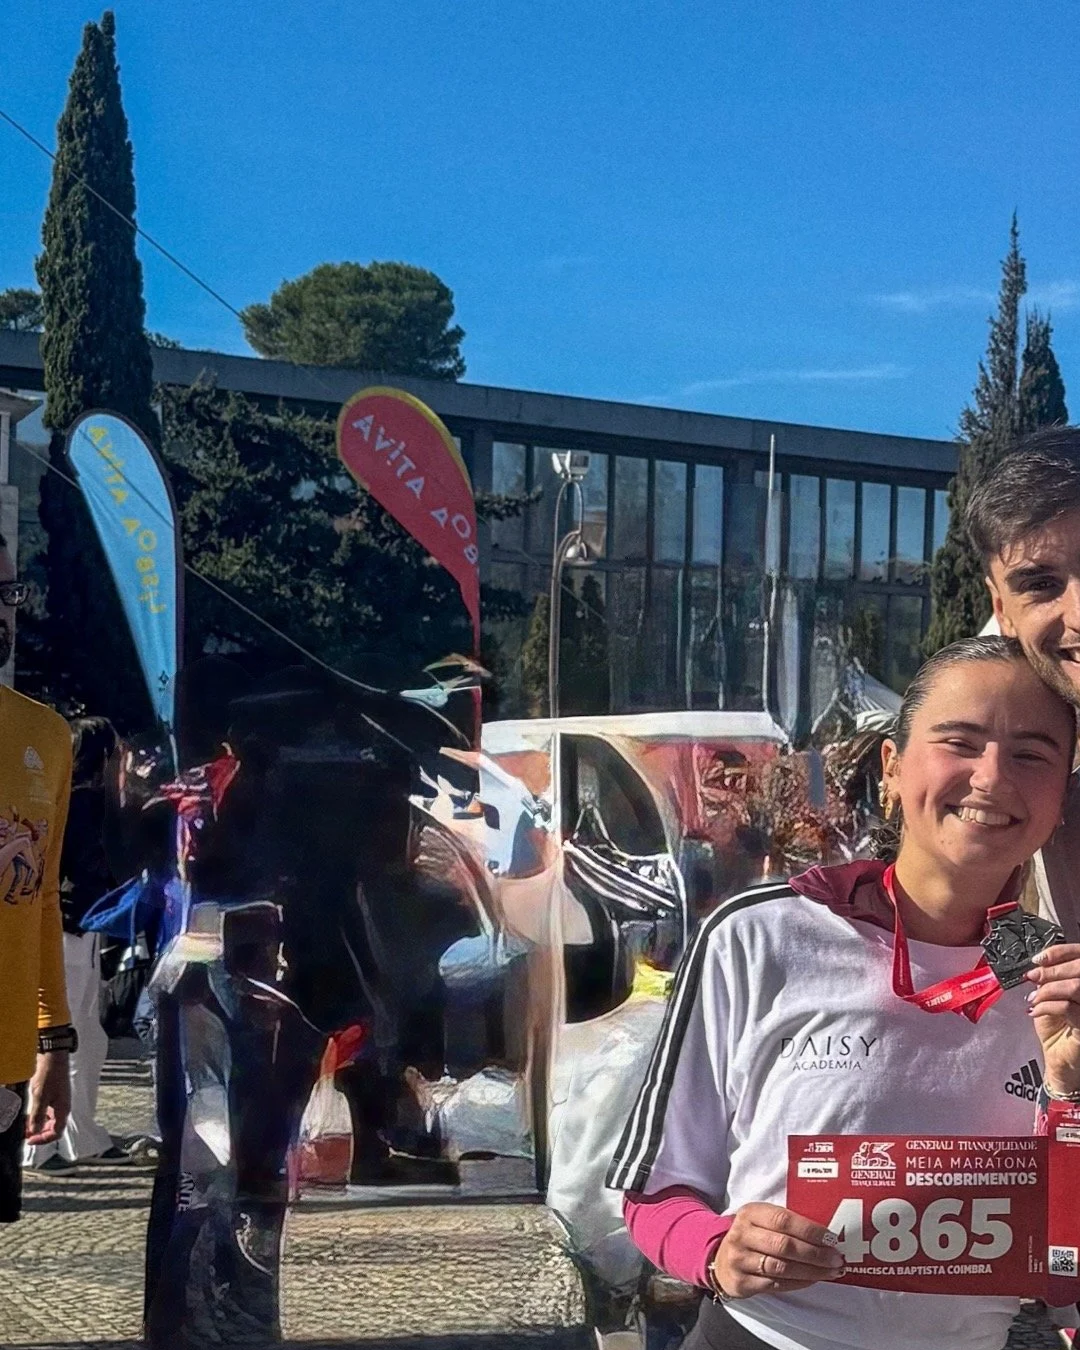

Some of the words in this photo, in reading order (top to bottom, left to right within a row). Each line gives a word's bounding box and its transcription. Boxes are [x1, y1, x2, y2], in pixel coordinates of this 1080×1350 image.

[780, 1035, 878, 1058] DAISY
[792, 1060, 863, 1072] ACADEMIA
[1004, 1081, 1039, 1102] adid
[905, 1140, 954, 1151] GENERALI
[958, 1140, 1038, 1151] TRANQUILIDADE
[906, 1156, 943, 1169] MEIA
[950, 1155, 1038, 1169] MARATONA
[905, 1171, 1037, 1186] DESCOBRIMENTOS
[827, 1197, 1014, 1263] 4865
[844, 1266, 895, 1276] RANCISCA
[896, 1265, 945, 1275] BAPTISTA
[946, 1263, 993, 1275] COIMBRA
